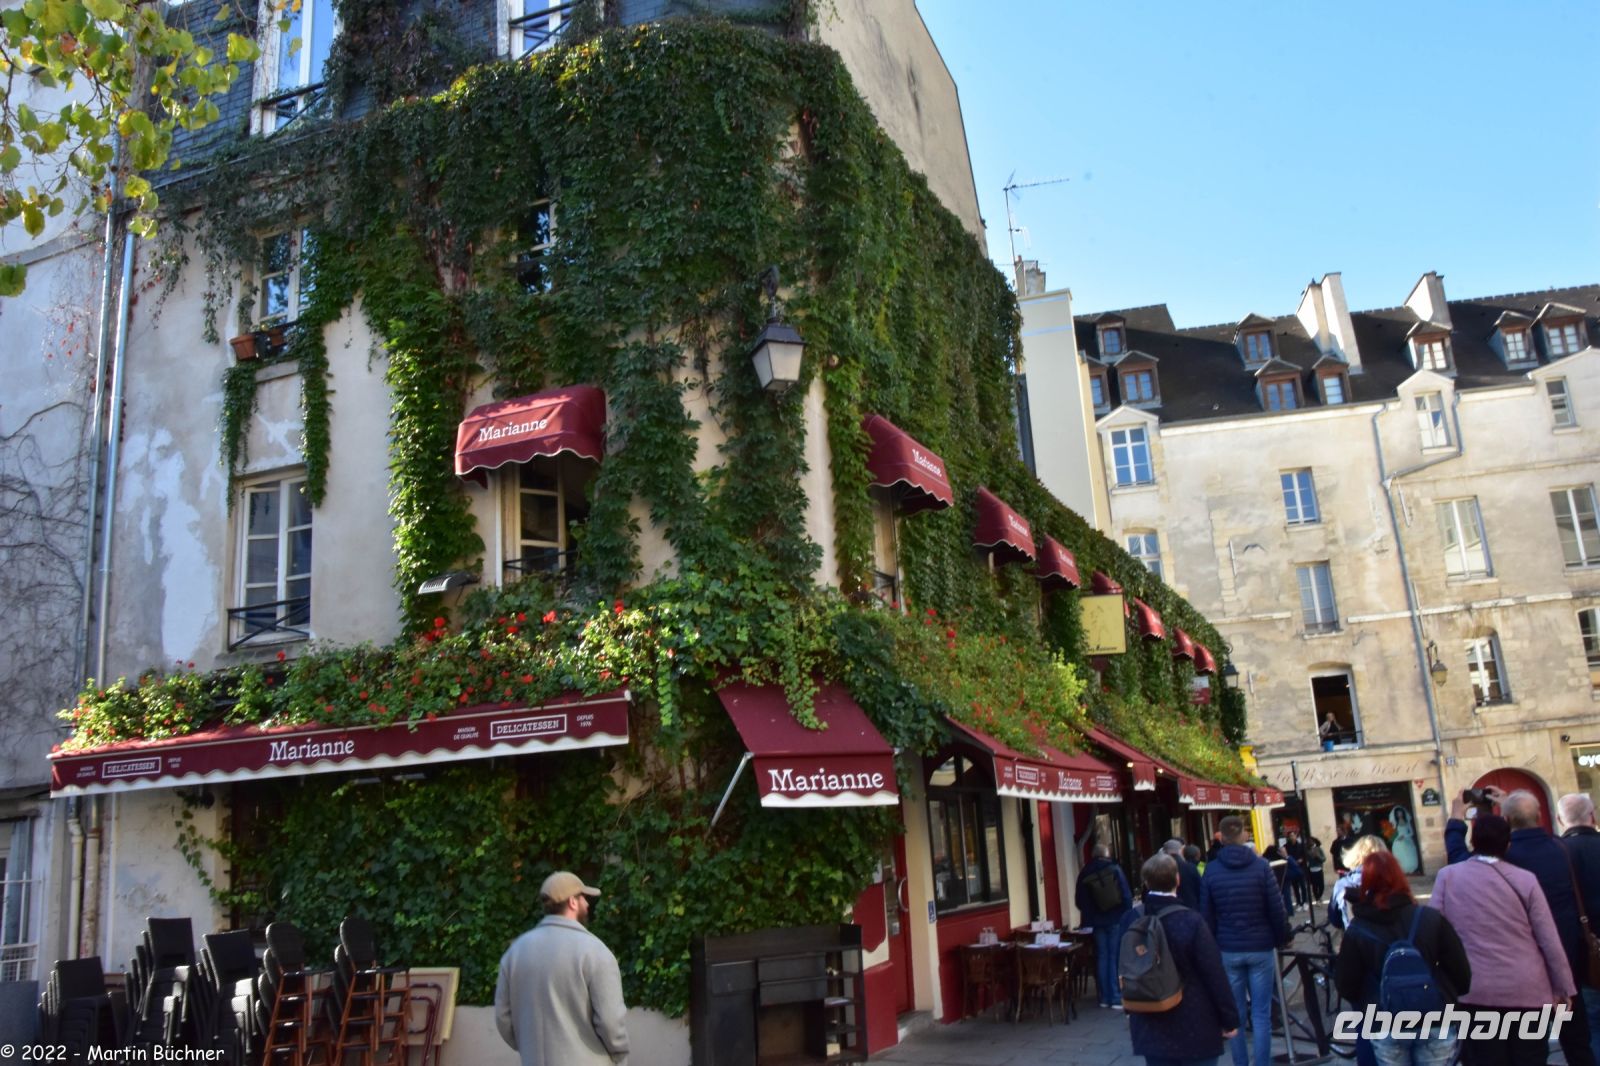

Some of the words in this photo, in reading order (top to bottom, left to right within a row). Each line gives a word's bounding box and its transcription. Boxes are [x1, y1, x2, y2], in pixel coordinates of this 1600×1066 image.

[479, 419, 548, 441] Marianne
[496, 719, 560, 735] DELICATESSEN
[269, 737, 355, 762] Marianne
[767, 767, 885, 792] Marianne
